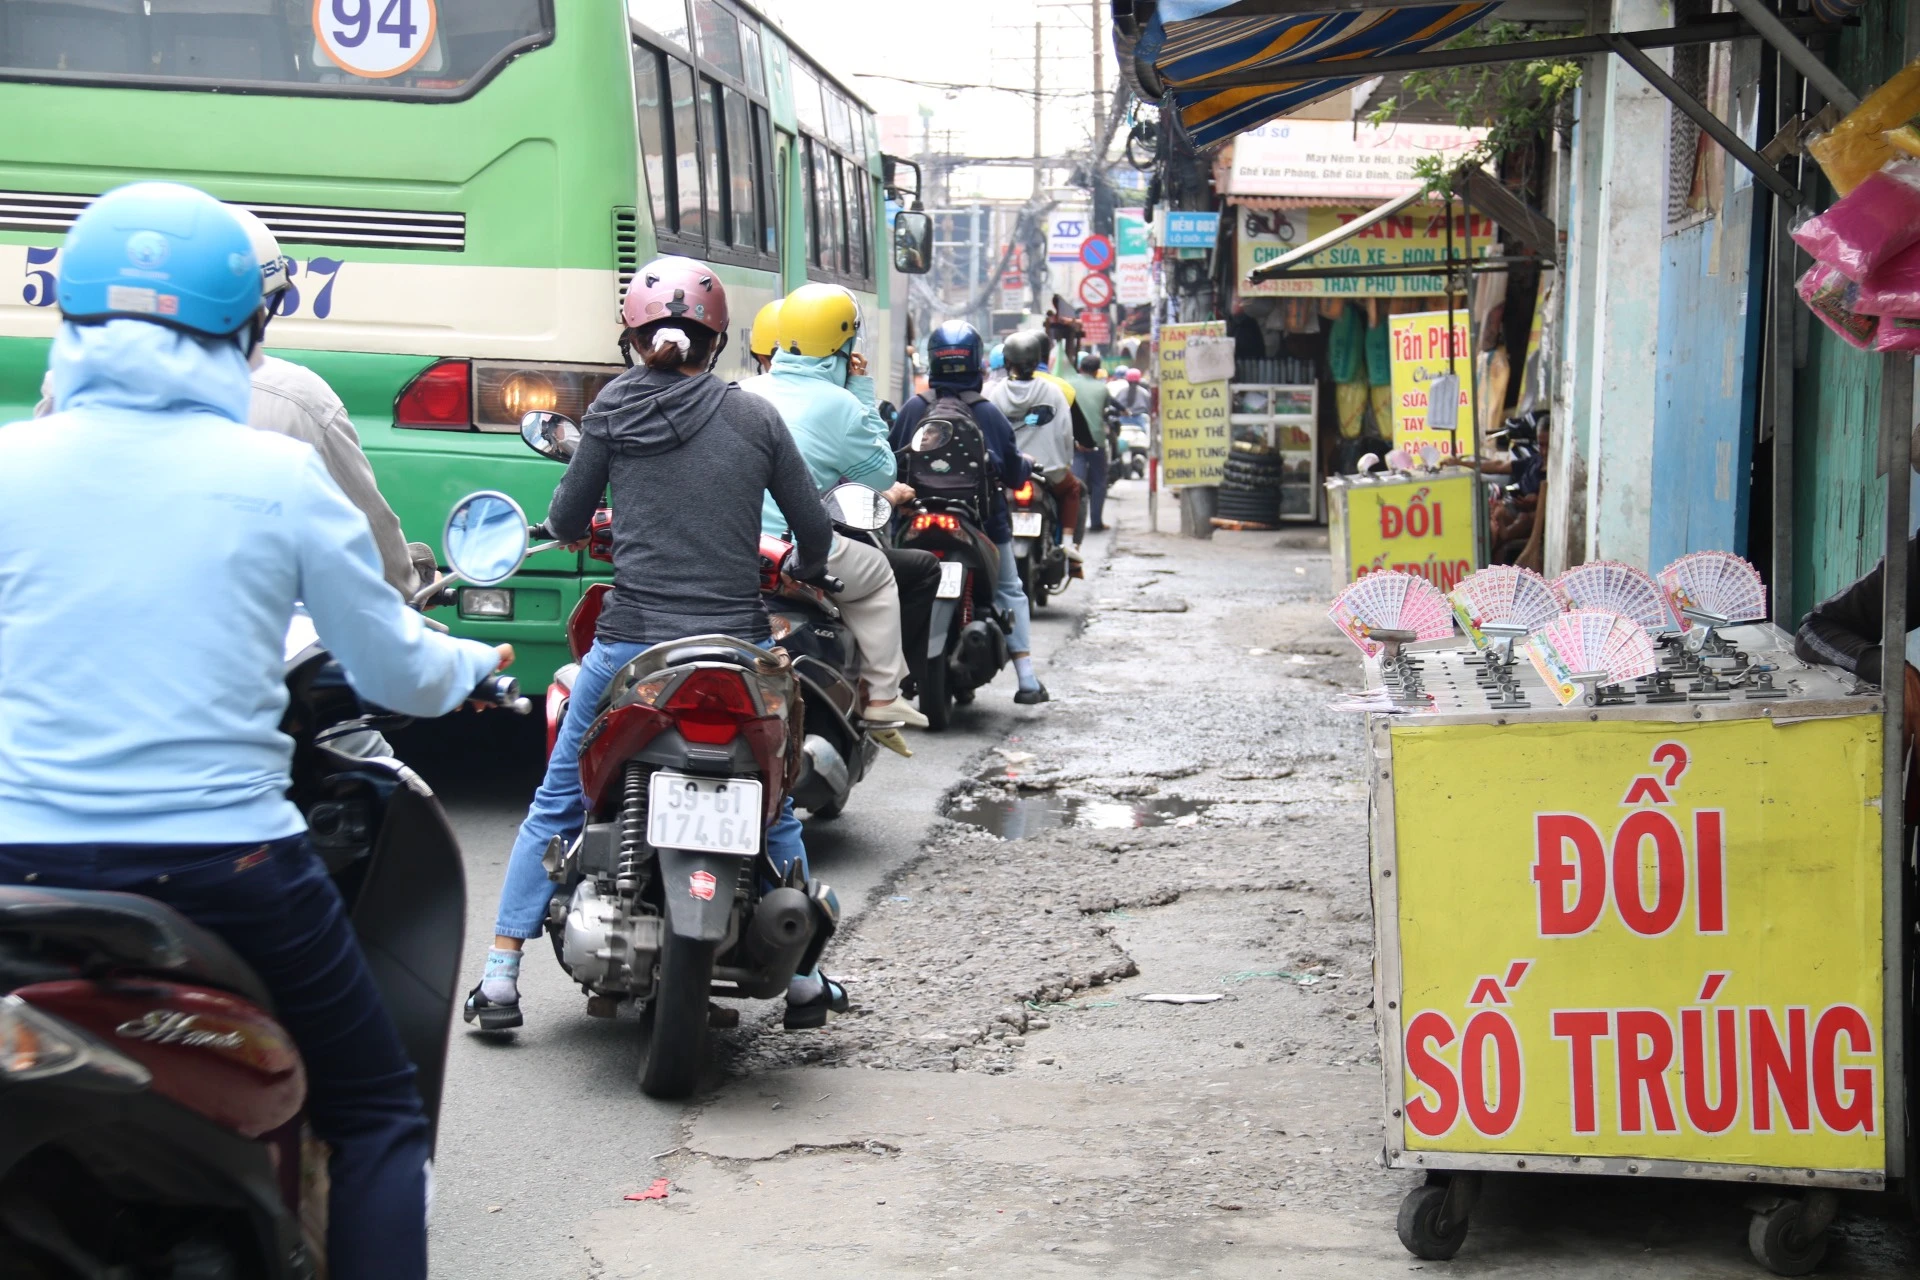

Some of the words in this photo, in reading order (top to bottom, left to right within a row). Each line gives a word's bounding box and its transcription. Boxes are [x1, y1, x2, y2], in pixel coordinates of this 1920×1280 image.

[332, 0, 418, 49] 94
[1367, 248, 1386, 265] XE
[1167, 388, 1195, 401] TAY
[1200, 387, 1220, 399] GA
[1168, 427, 1199, 439] THAY
[1403, 417, 1425, 431] TAY
[1380, 487, 1442, 539] ĐỔI
[656, 812, 753, 849] 174.64
[1533, 742, 1726, 936] ĐỔI
[1405, 960, 1529, 1136] SỐ
[1552, 972, 1876, 1134] TRÚNG
